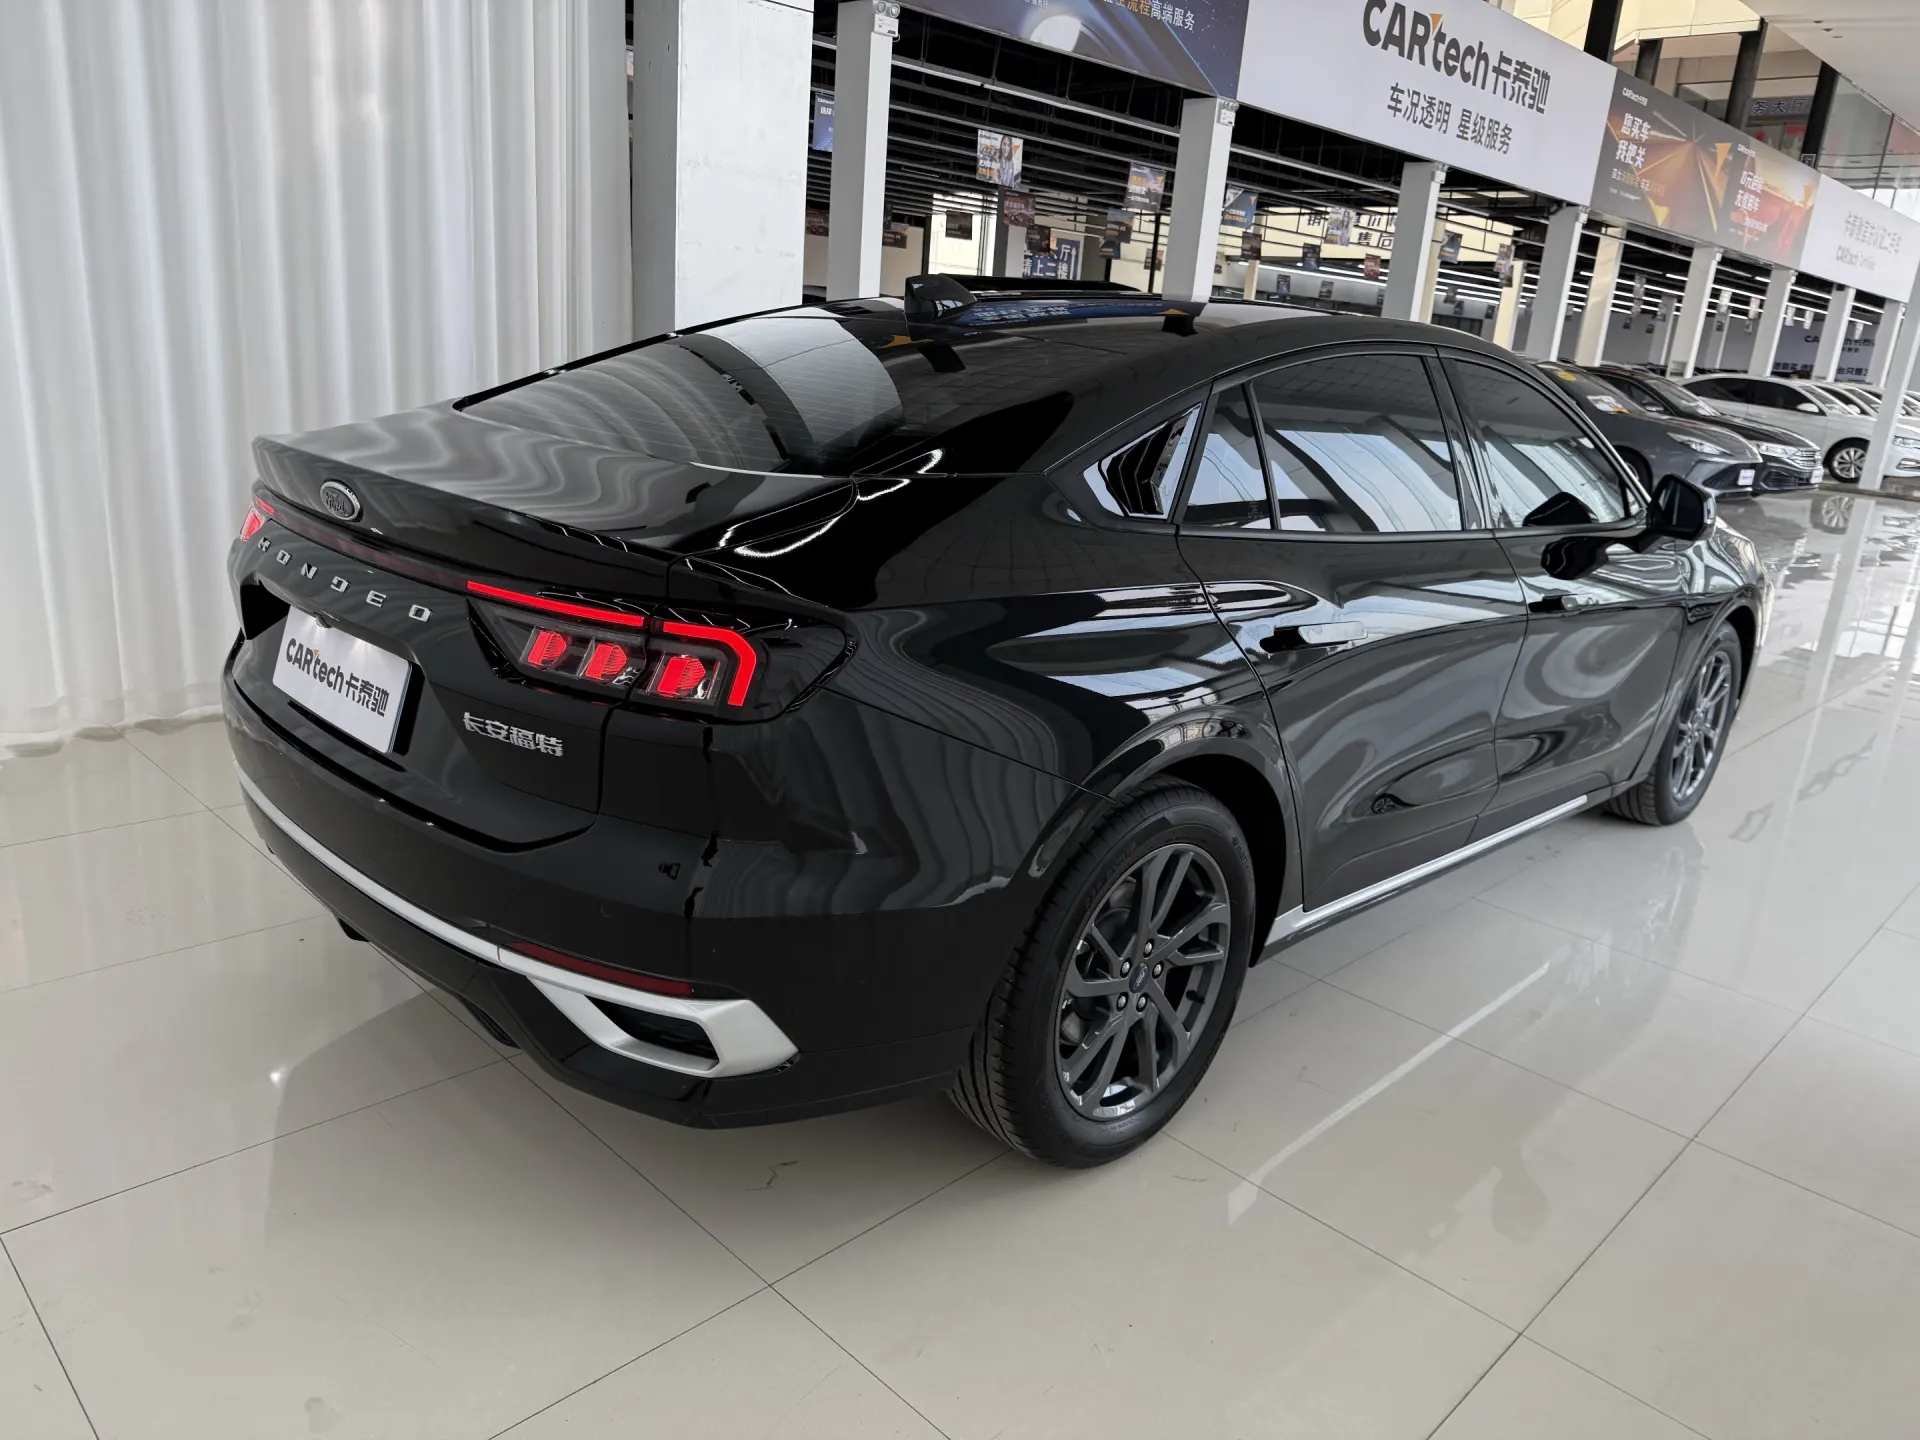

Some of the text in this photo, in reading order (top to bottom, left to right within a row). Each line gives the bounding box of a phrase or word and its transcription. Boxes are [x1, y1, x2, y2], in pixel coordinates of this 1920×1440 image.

[1363, 0, 1551, 115] CARtech 卡泰驰
[1387, 82, 1513, 155] 车况透明 星级服务
[1615, 139, 1646, 169] 我把关
[1621, 112, 1651, 142] 您买车
[257, 536, 433, 623] MONDEO
[286, 637, 390, 718] CARtech 卡泰驰
[463, 711, 564, 757] 长安福特
